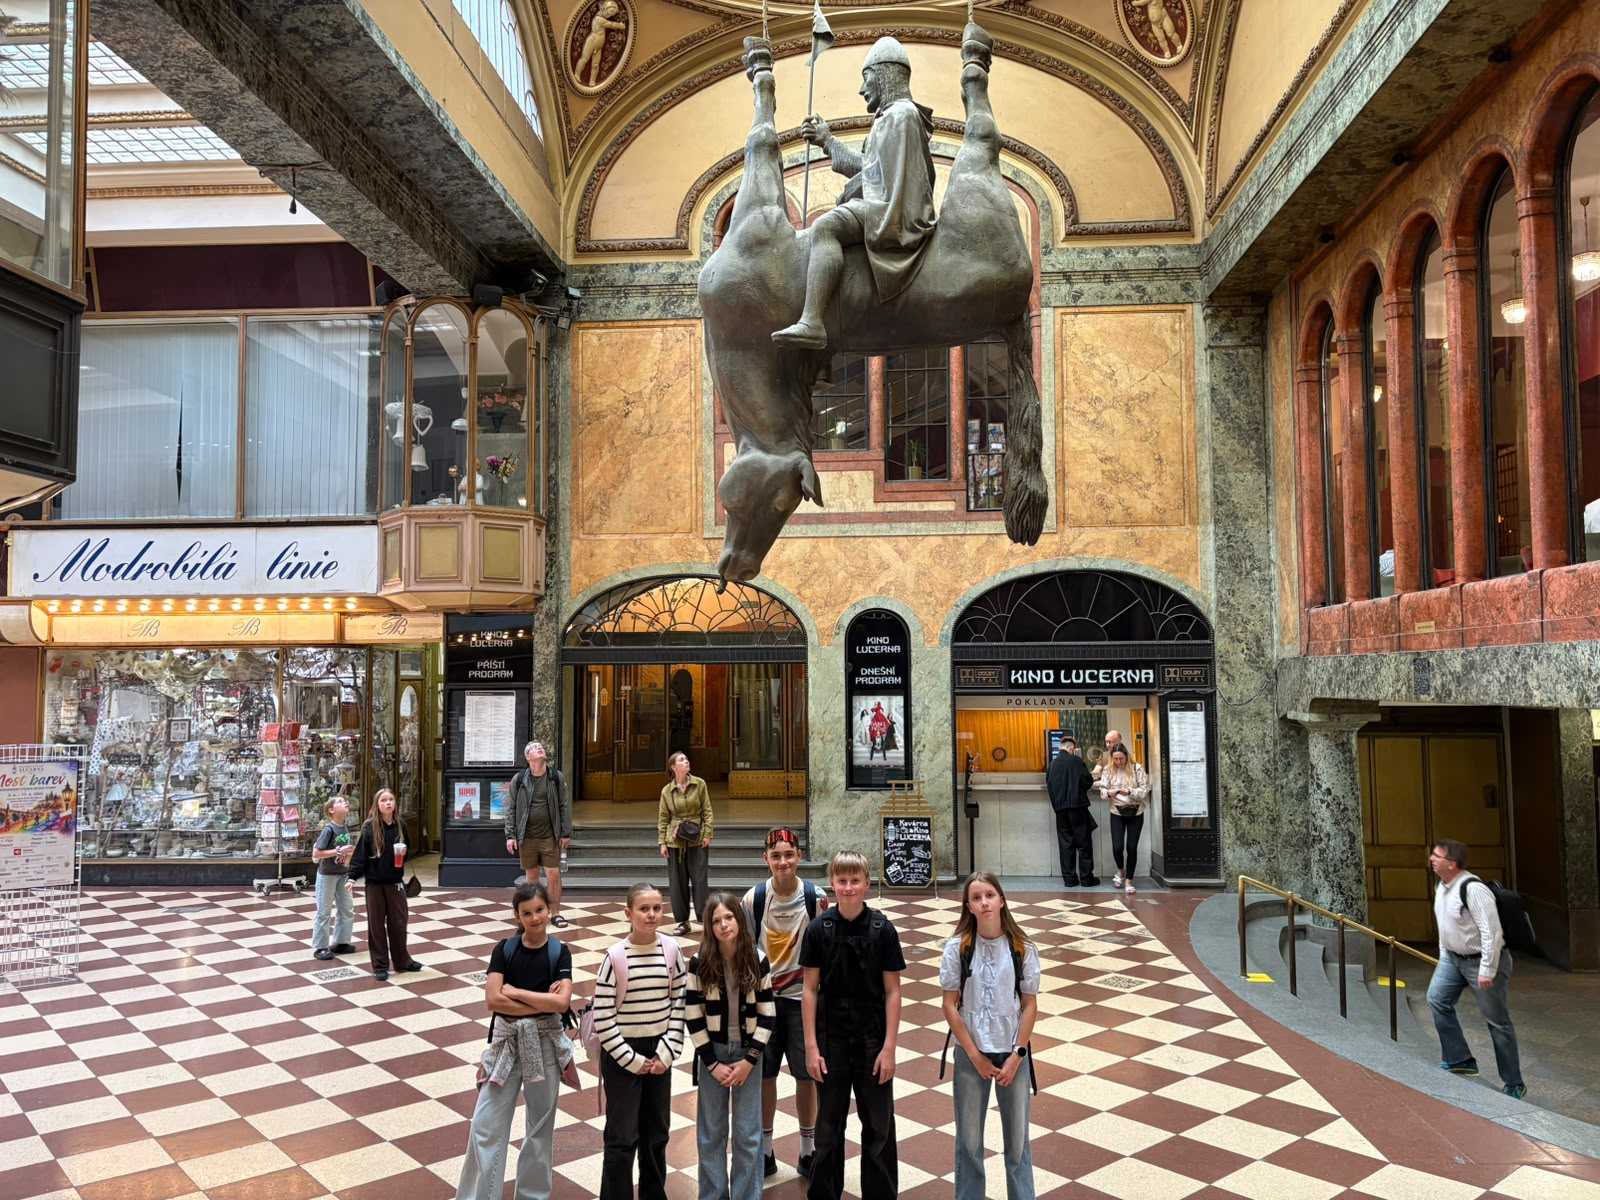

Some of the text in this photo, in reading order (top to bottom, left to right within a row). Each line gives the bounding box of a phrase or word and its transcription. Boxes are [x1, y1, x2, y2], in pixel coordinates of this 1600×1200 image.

[33, 537, 339, 583] Modrobílá linie
[470, 639, 513, 648] LUCERNA
[866, 636, 890, 645] KINO
[856, 645, 901, 654] LUCERNA
[468, 670, 514, 679] PROGRAM
[860, 666, 896, 676] DNEŠNÍ
[855, 676, 902, 685] PROGRAM
[1010, 669, 1154, 684] KINO LUCERNA
[1006, 698, 1076, 706] POKLADNA
[29, 773, 65, 787] barev
